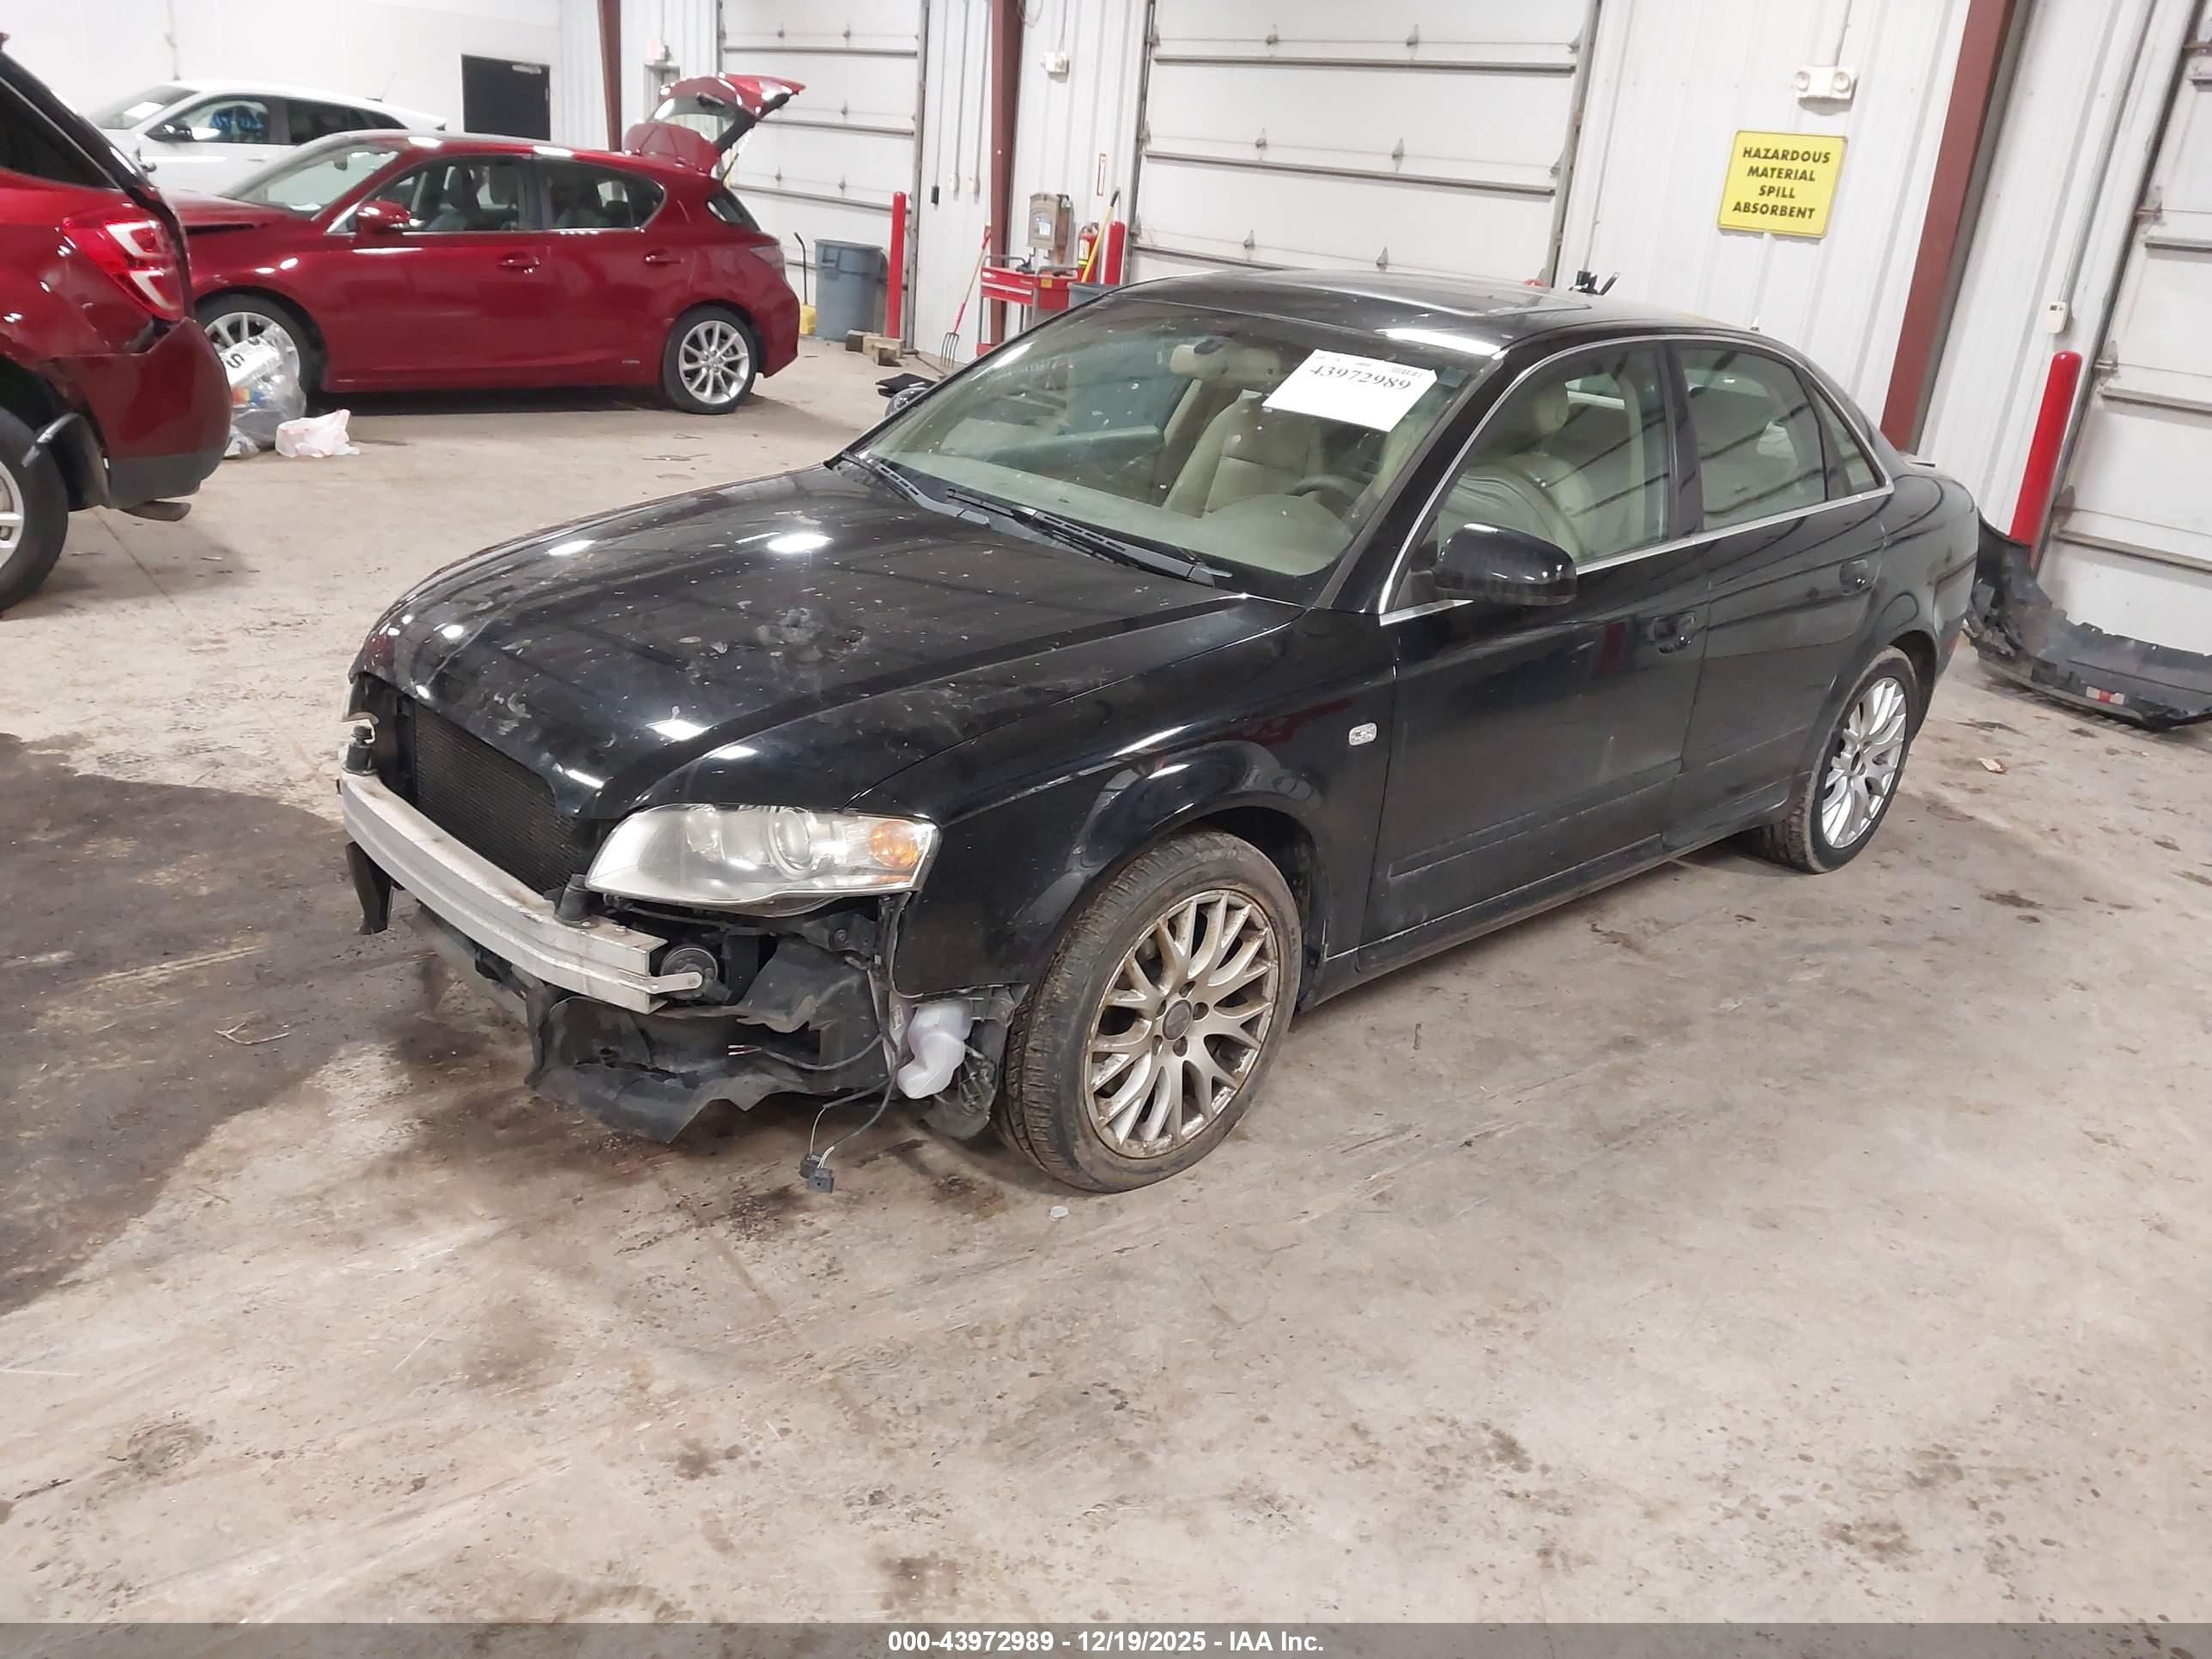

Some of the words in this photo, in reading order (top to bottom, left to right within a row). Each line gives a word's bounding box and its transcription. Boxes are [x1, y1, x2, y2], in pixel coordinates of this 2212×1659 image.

[1742, 147, 1831, 163] HAZARDOUS
[1747, 166, 1815, 181] MATERIAL
[1758, 185, 1796, 198] SPILL
[1732, 201, 1816, 219] ABSORBENT
[1310, 365, 1412, 389] 43972989
